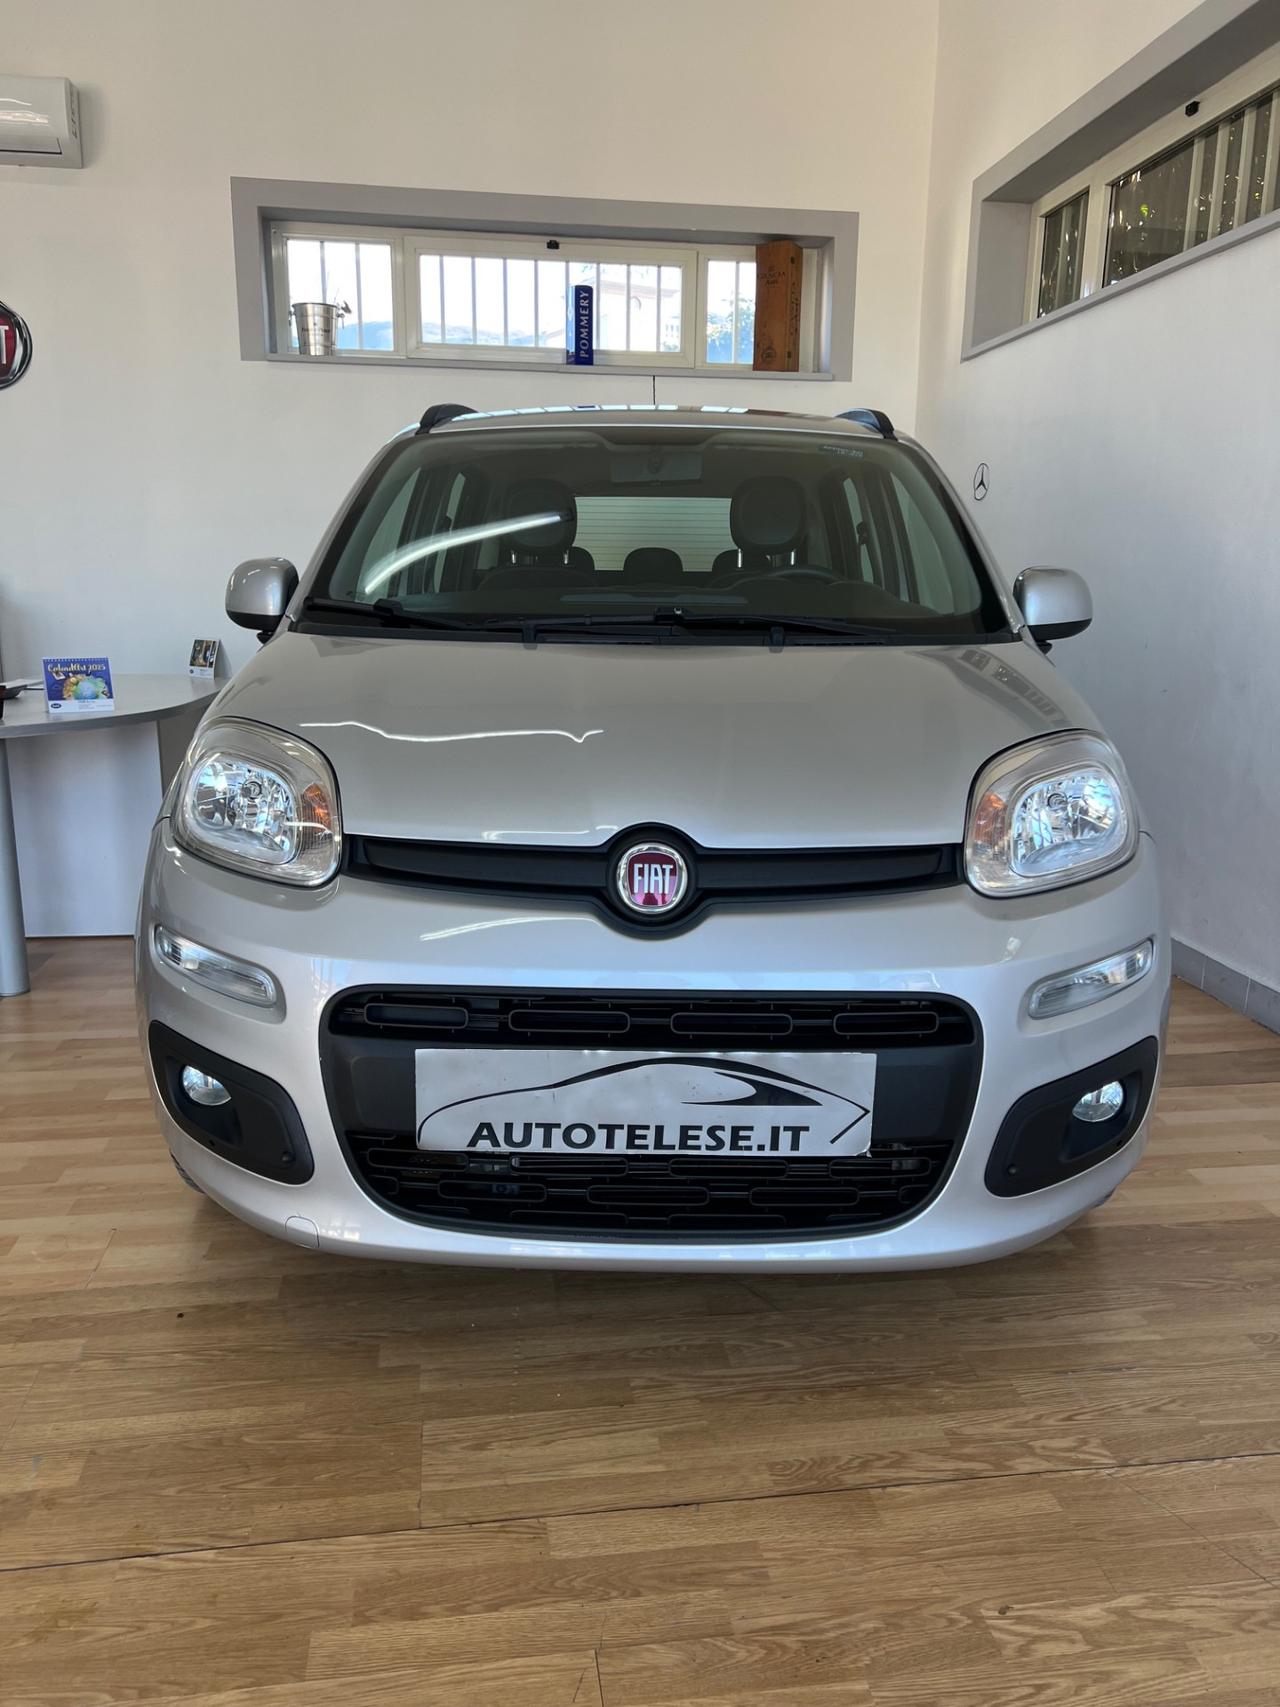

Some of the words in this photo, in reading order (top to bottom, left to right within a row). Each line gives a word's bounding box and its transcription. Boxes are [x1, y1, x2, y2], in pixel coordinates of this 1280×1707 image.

[579, 290, 589, 358] POMMERY
[87, 663, 106, 672] 2025
[633, 863, 674, 894] FIAT
[466, 1121, 810, 1152] AUTOTELESE.IT
